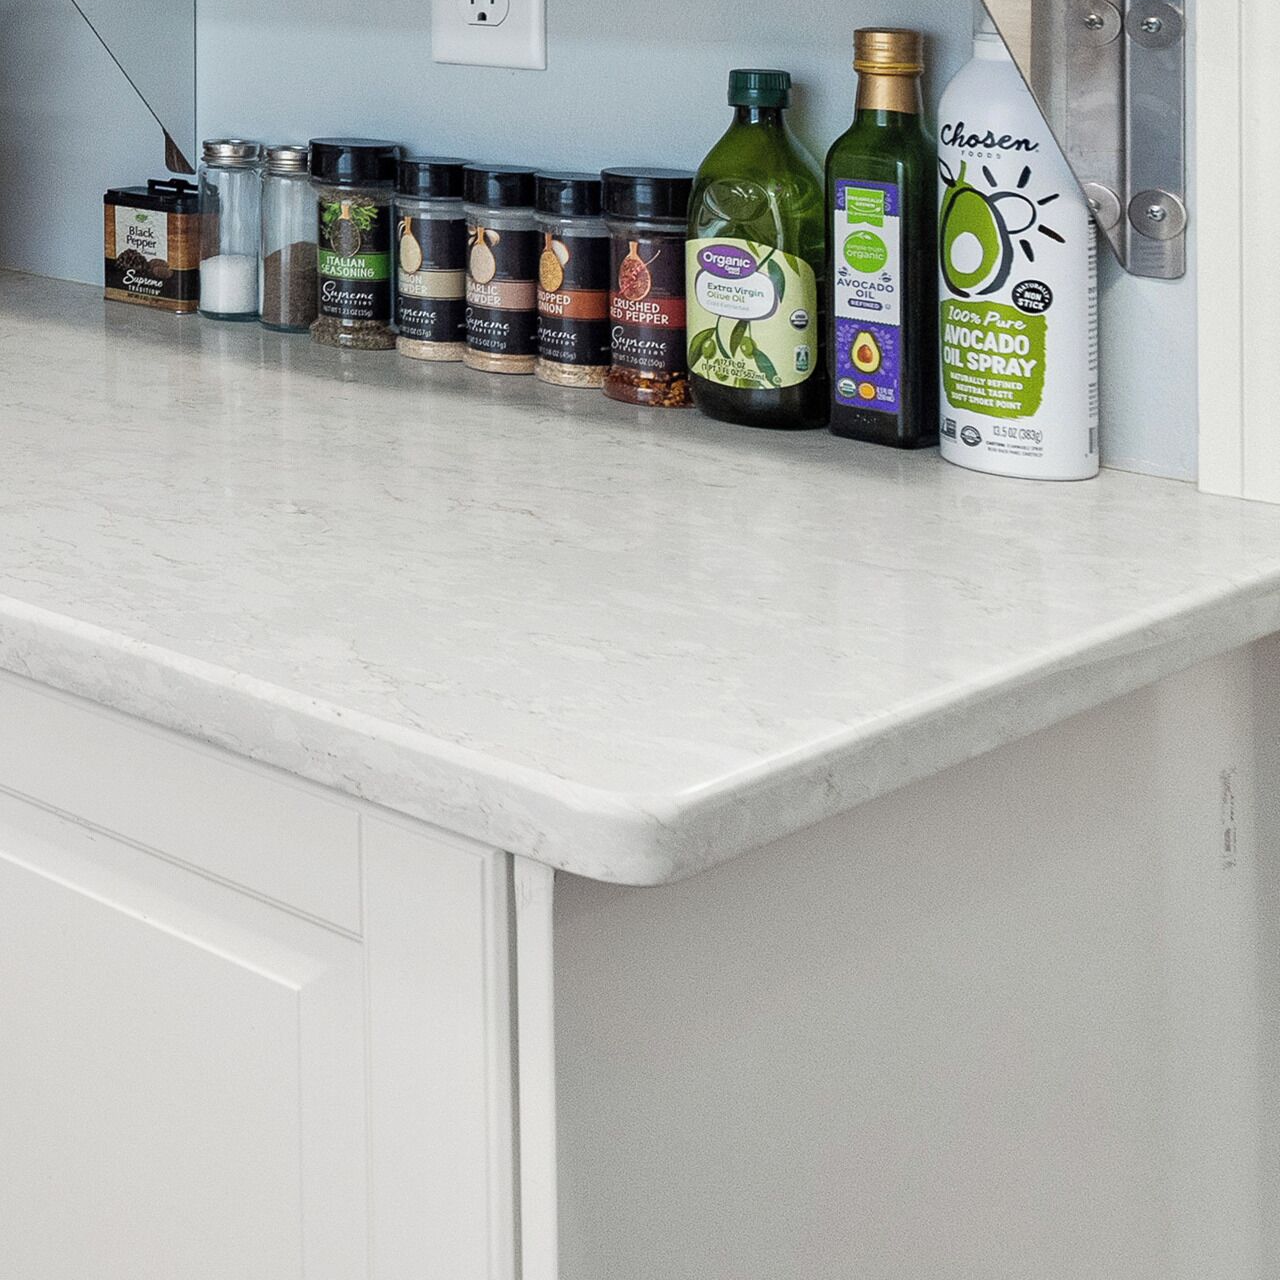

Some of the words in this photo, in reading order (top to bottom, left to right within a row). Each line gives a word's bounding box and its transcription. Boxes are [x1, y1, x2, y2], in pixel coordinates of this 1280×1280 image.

[940, 121, 1039, 152] Chosen
[129, 226, 154, 238] Black
[126, 235, 156, 249] Pepper
[326, 255, 365, 268] ITALIAN
[703, 251, 751, 268] Organic
[846, 249, 884, 261] organic
[321, 264, 374, 277] SEASONING
[122, 269, 163, 288] Supreme
[707, 282, 732, 293] Extra
[735, 286, 765, 298] Virgin
[837, 278, 894, 294] AVOCADO
[1015, 282, 1050, 299] NATURALLY
[707, 290, 730, 301] Olive
[732, 294, 745, 303] Oil
[856, 290, 875, 300] OIL
[1023, 291, 1042, 301] NON
[613, 298, 660, 313] CRUSHED
[1017, 298, 1045, 311] STICK
[626, 311, 669, 324] PEPPER
[948, 305, 981, 325] 100%
[983, 311, 1027, 330] Pure
[944, 324, 1030, 356] AVOCADO
[943, 346, 964, 368] OIL
[966, 351, 1037, 378] SPRAY
[996, 400, 1022, 410] POINT
